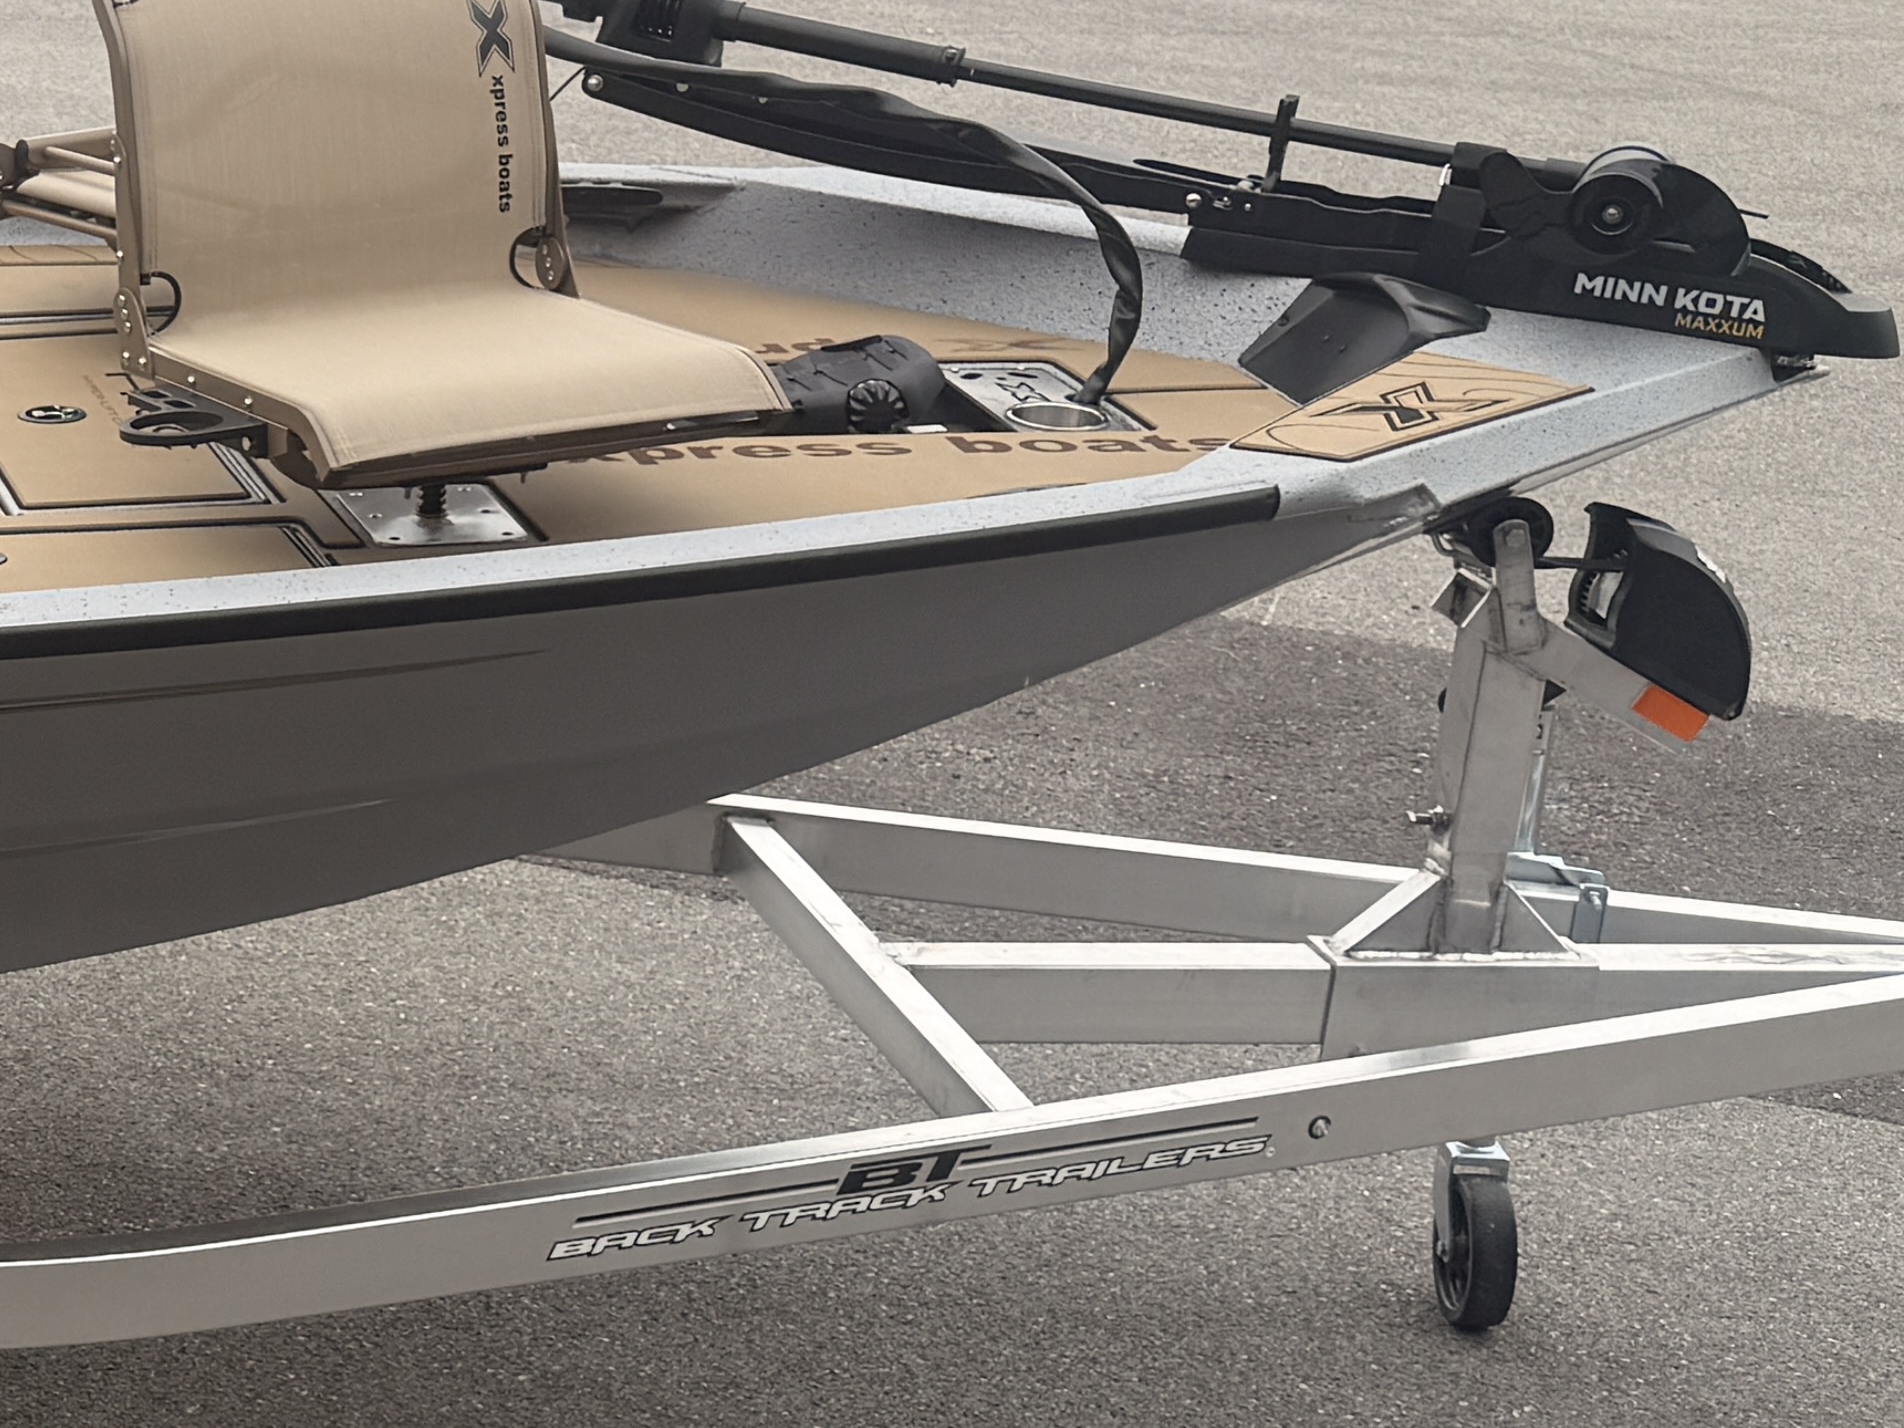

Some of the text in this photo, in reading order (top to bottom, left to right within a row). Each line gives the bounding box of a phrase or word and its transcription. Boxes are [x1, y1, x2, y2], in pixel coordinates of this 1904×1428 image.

[489, 74, 514, 214] xpress boats
[1573, 272, 1766, 323] MINN KOTA
[1674, 312, 1765, 340] MAXXUM
[836, 1143, 992, 1196] BT
[546, 1133, 1273, 1262] BACK TRACK TRAILERS
